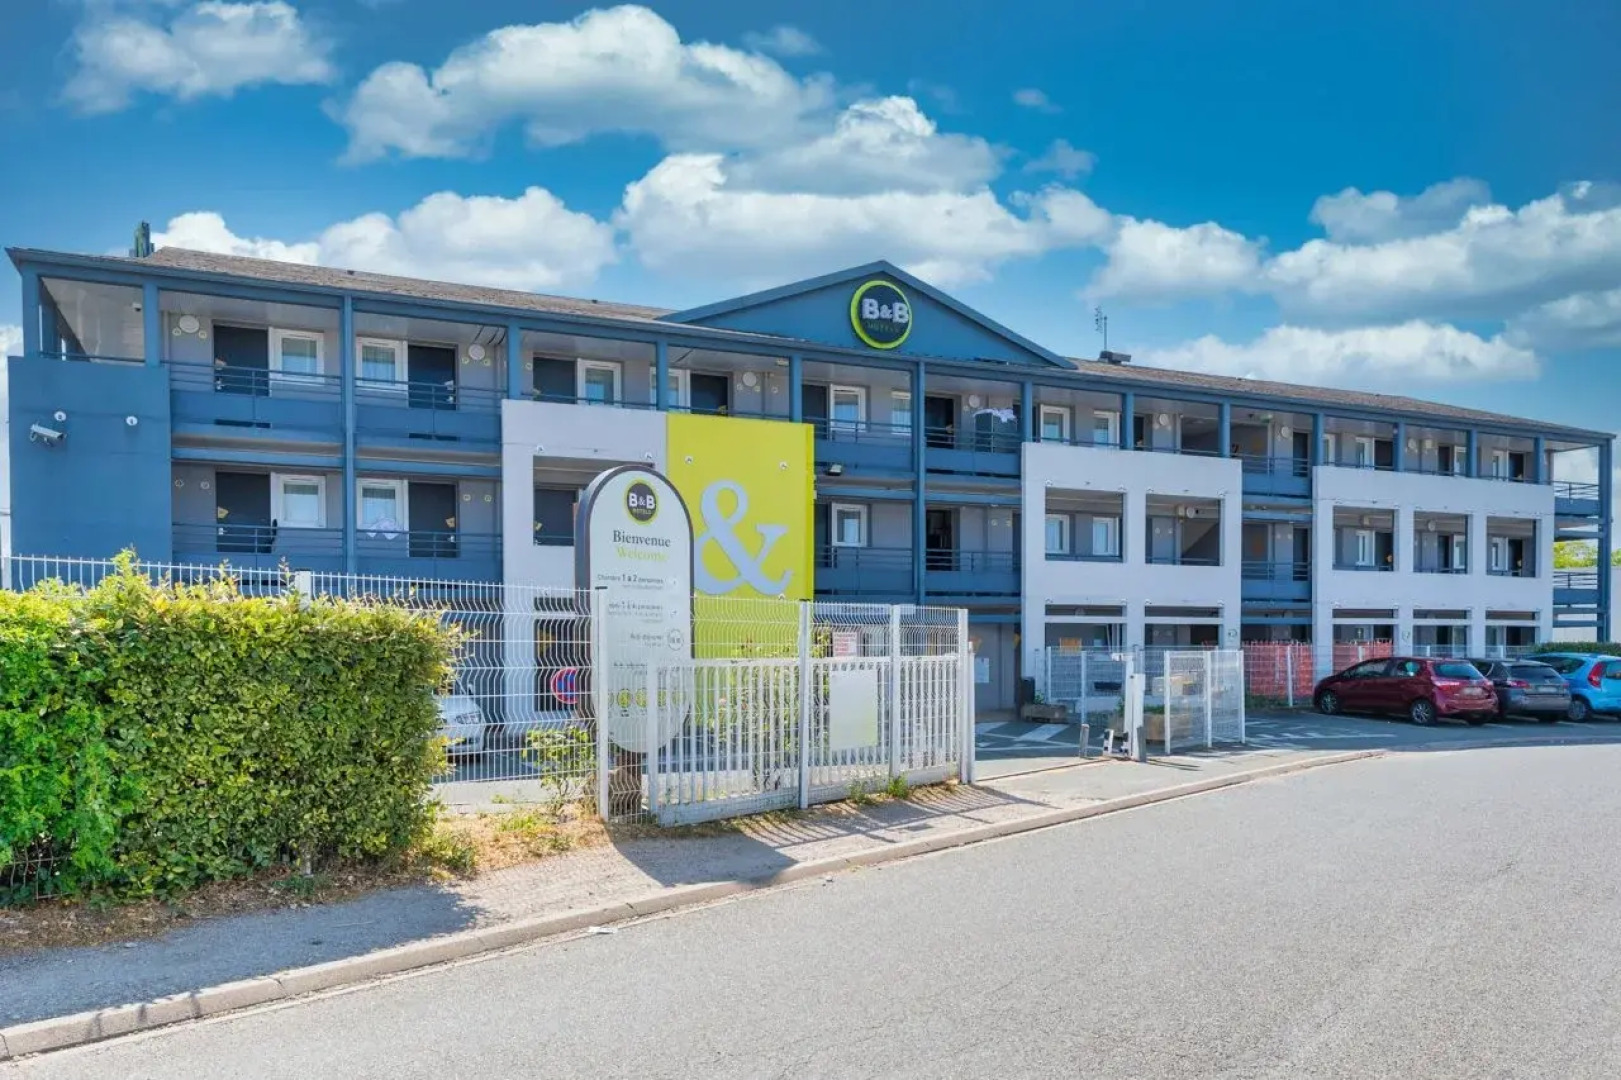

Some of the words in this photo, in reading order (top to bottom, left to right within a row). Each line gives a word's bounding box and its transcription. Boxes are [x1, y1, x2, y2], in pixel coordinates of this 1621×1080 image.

[862, 298, 908, 323] B&B
[628, 493, 655, 509] B&B
[613, 529, 671, 547] Bienvenue
[694, 479, 794, 596] &
